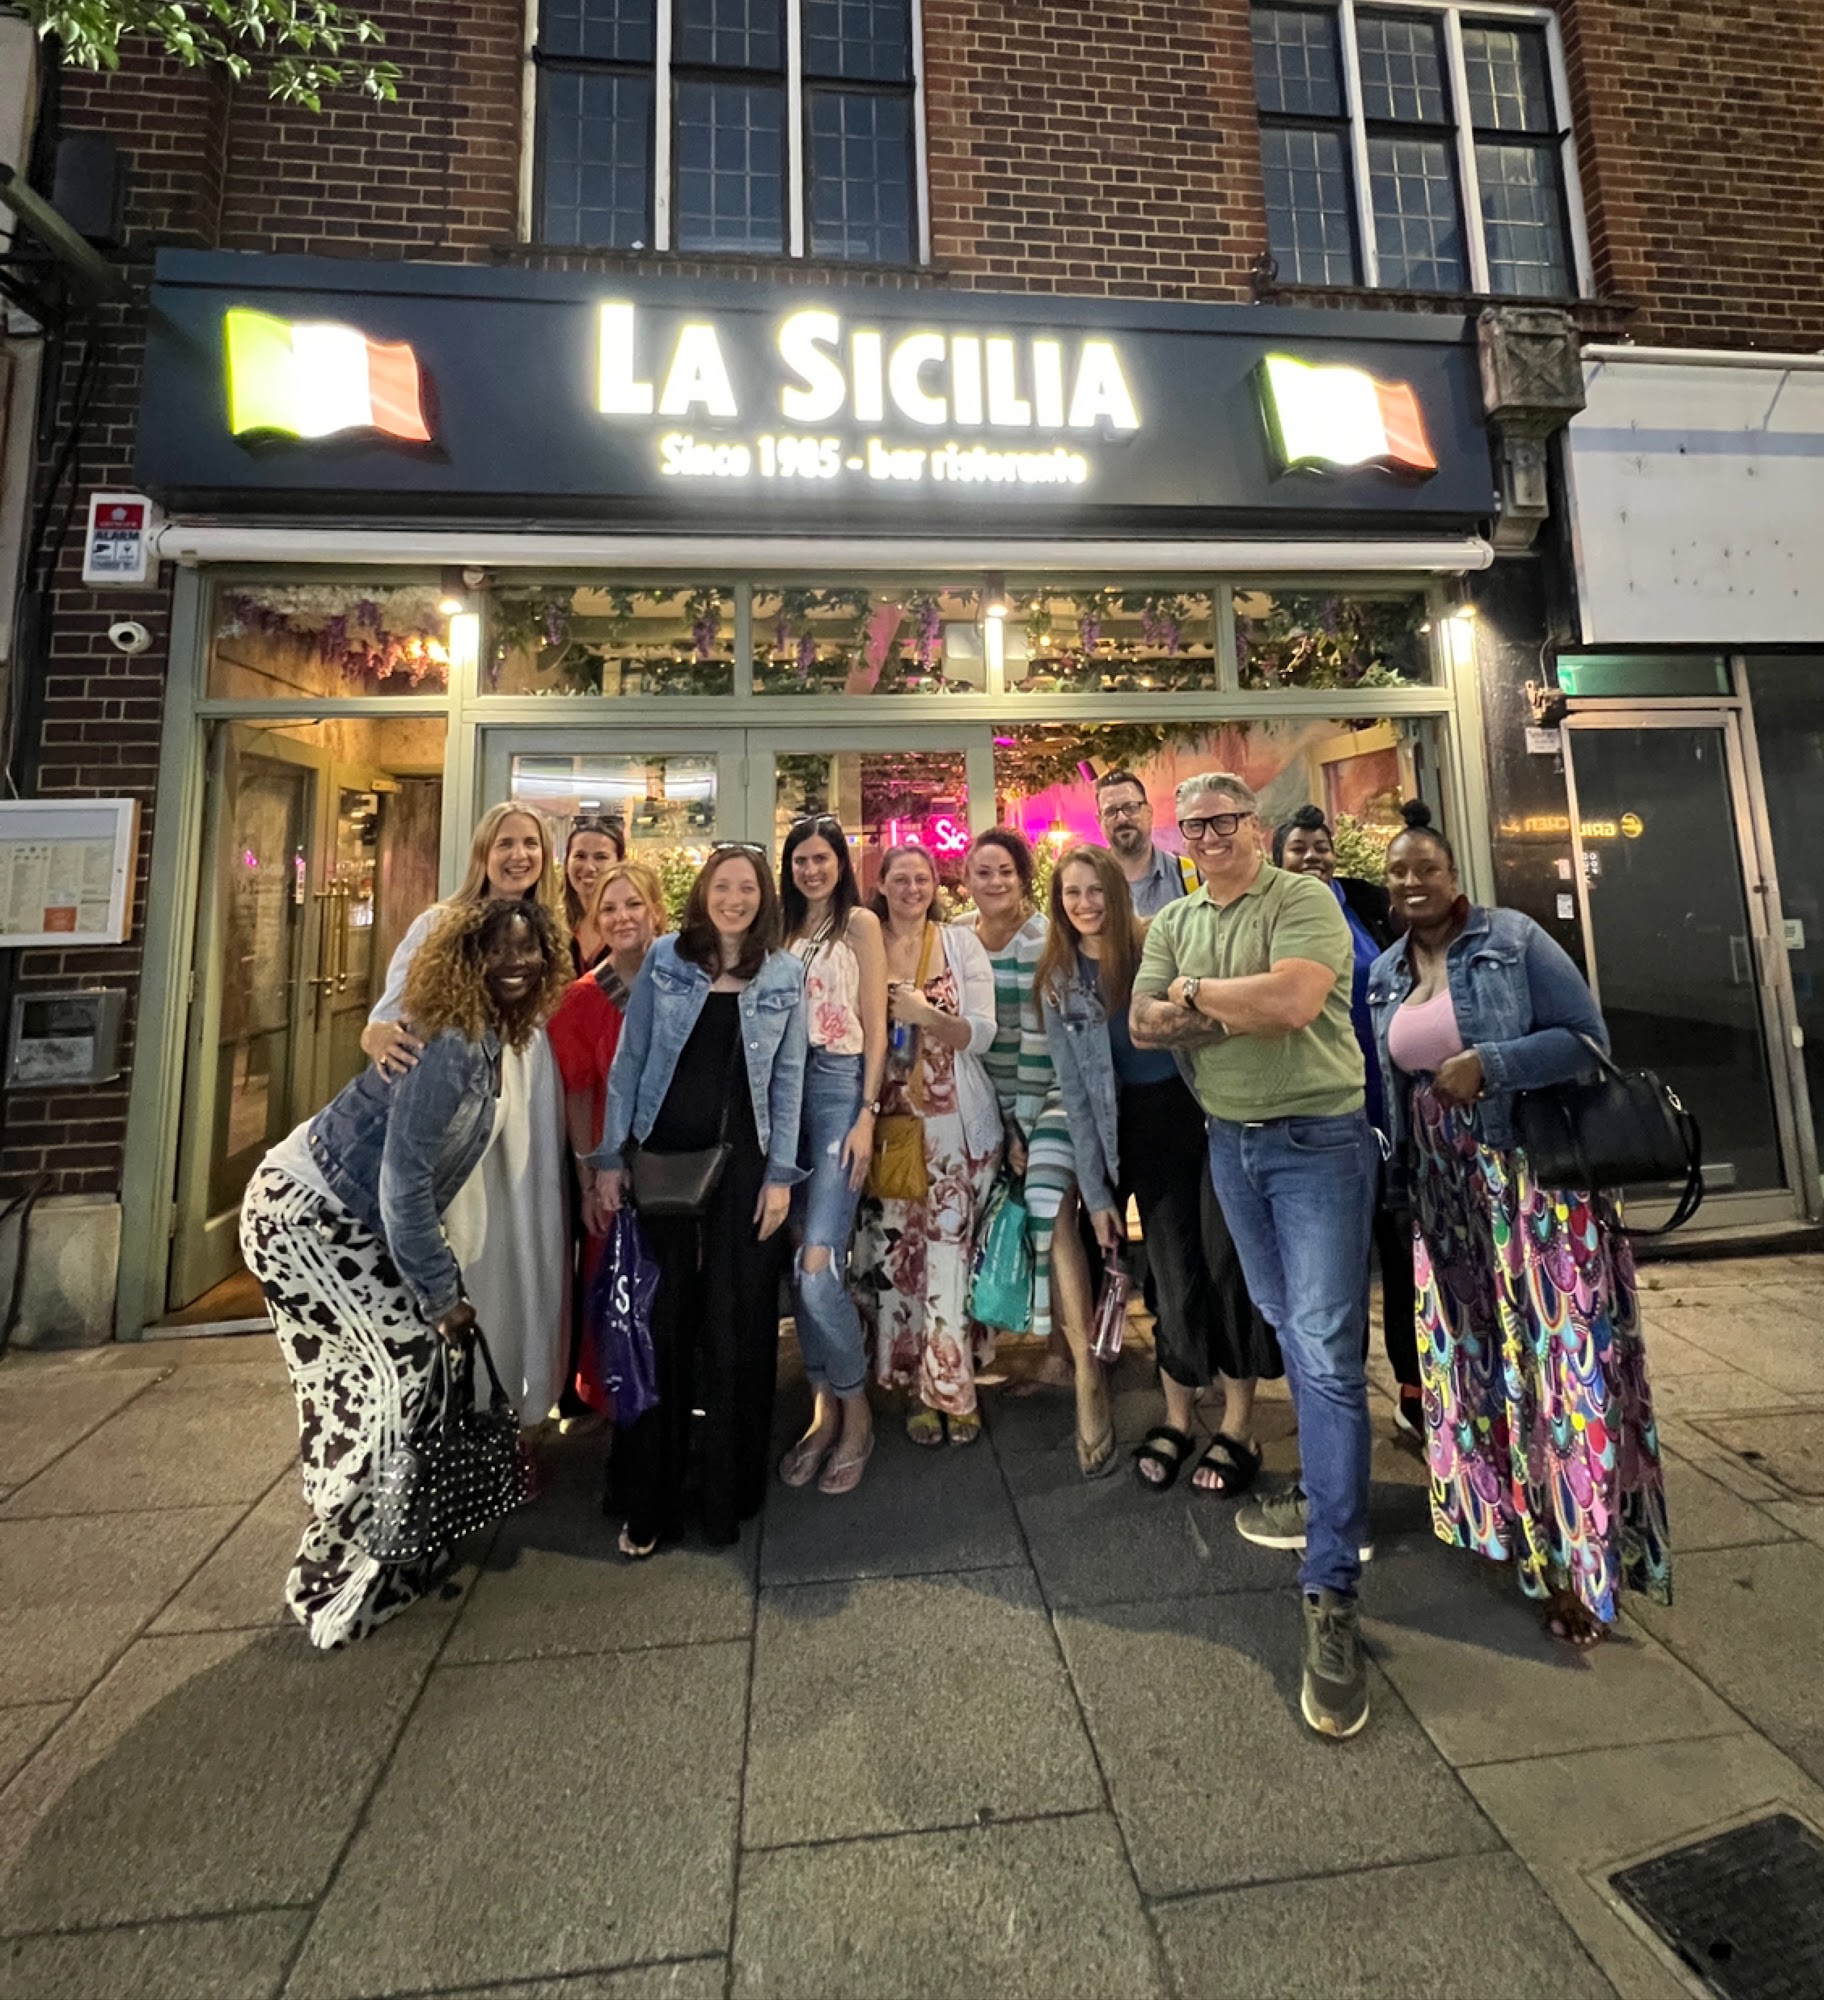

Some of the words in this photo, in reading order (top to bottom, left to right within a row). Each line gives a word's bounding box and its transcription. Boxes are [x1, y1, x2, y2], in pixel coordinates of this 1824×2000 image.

[598, 303, 738, 418] LA
[778, 309, 1141, 429] SICILIA
[659, 433, 751, 476] Since
[94, 531, 140, 541] ALARM
